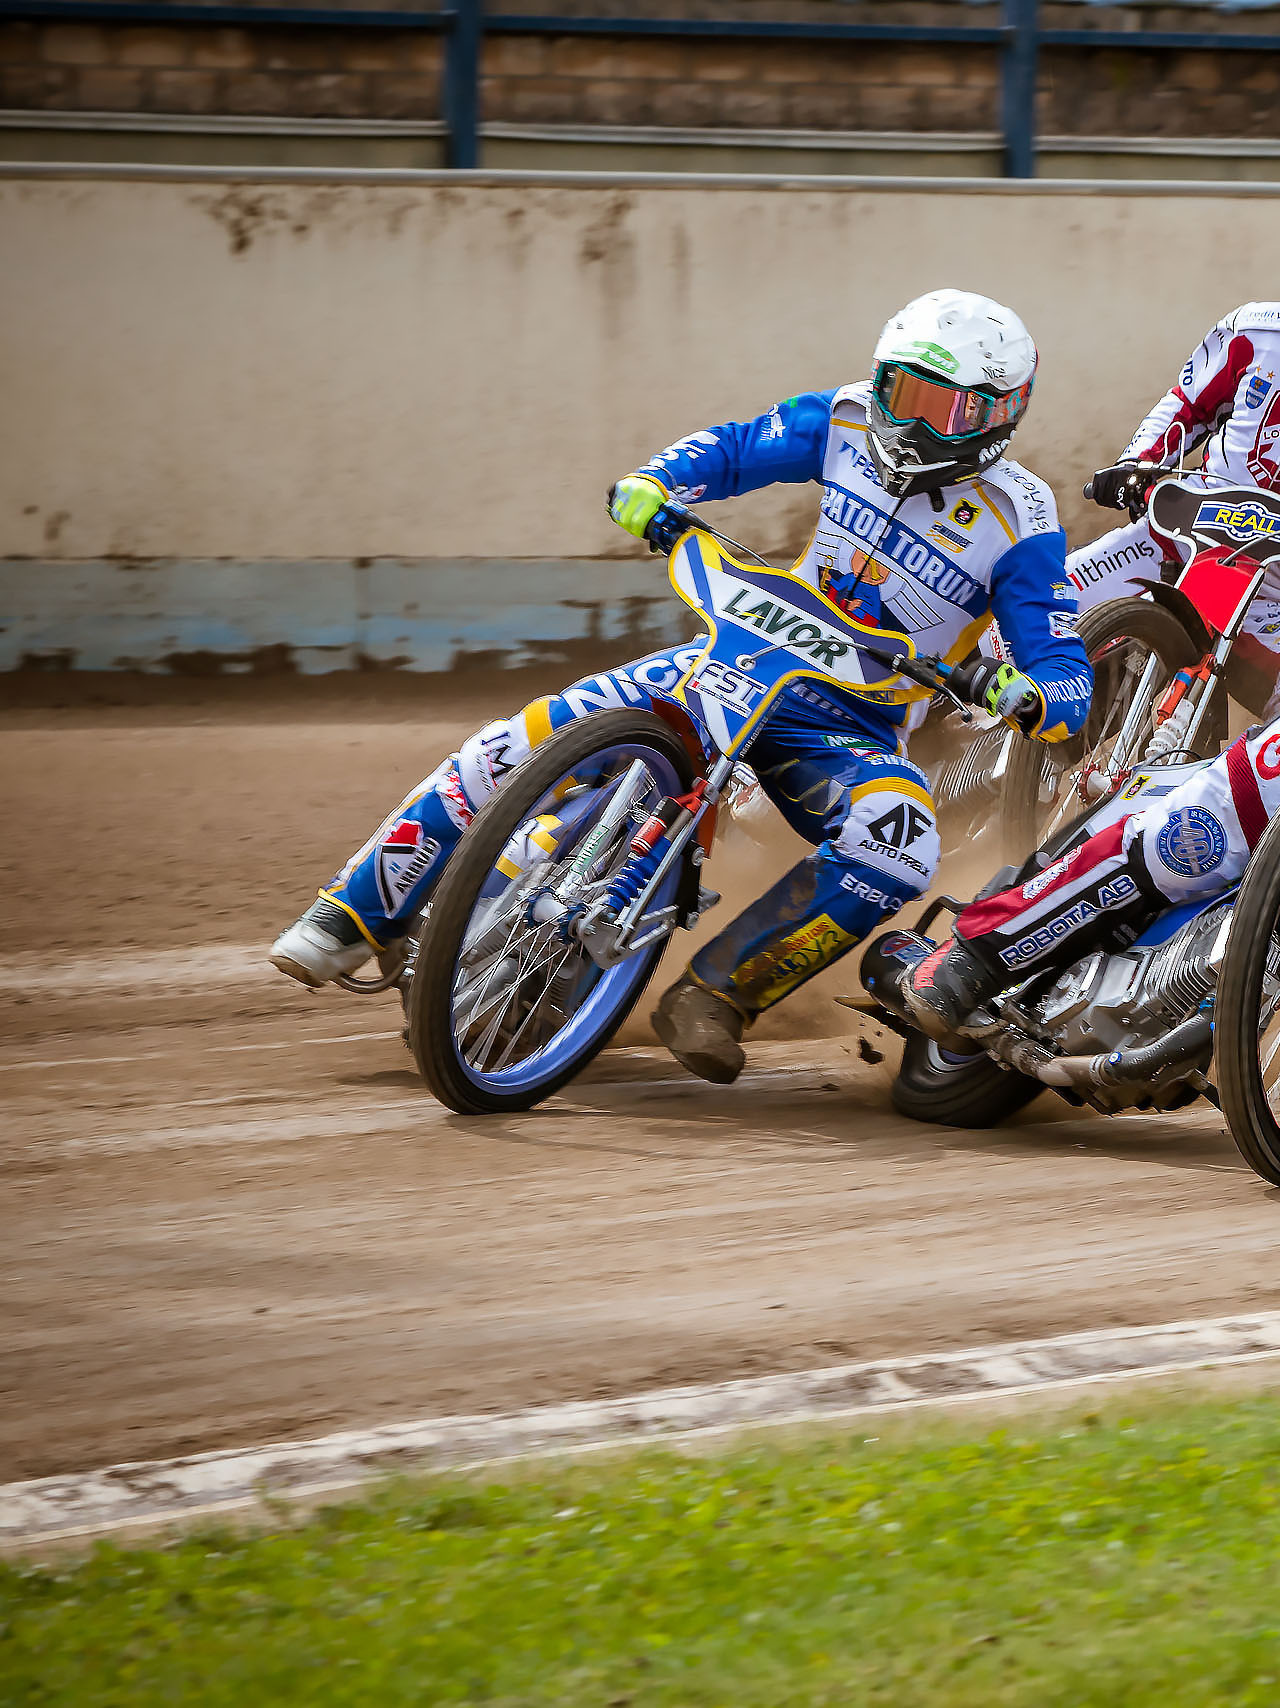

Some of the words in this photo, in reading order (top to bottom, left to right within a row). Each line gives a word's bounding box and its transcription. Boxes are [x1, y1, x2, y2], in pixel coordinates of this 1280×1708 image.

[1214, 507, 1279, 534] REALL
[721, 587, 850, 669] LAVOR
[998, 899, 1099, 970] ROBOTA
[1097, 874, 1139, 910] AB
